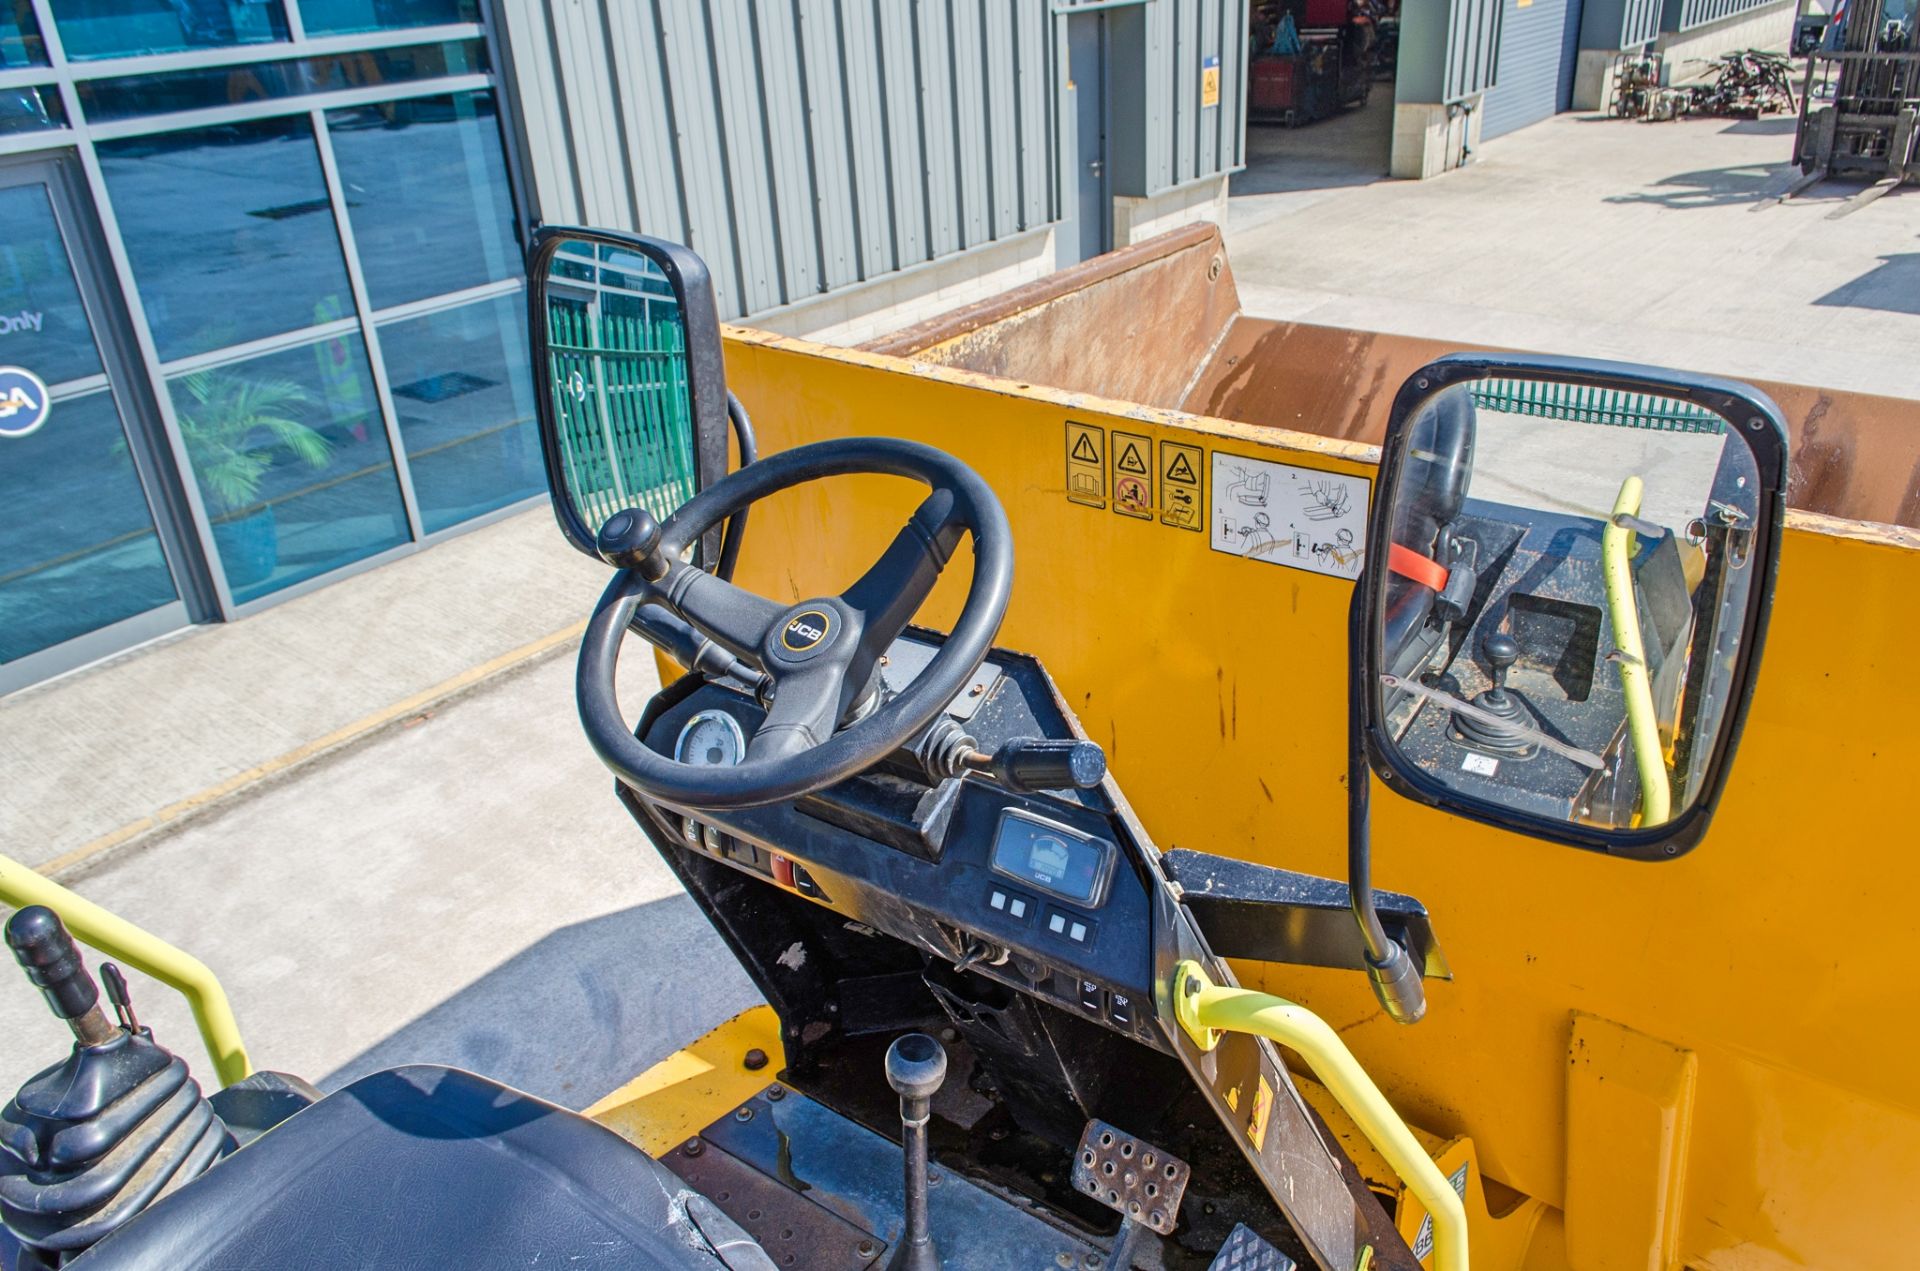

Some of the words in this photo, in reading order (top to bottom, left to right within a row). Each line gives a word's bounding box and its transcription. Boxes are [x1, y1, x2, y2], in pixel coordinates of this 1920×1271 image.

[0, 310, 43, 335] Only
[789, 620, 822, 641] JCB
[1034, 872, 1052, 883] JCB
